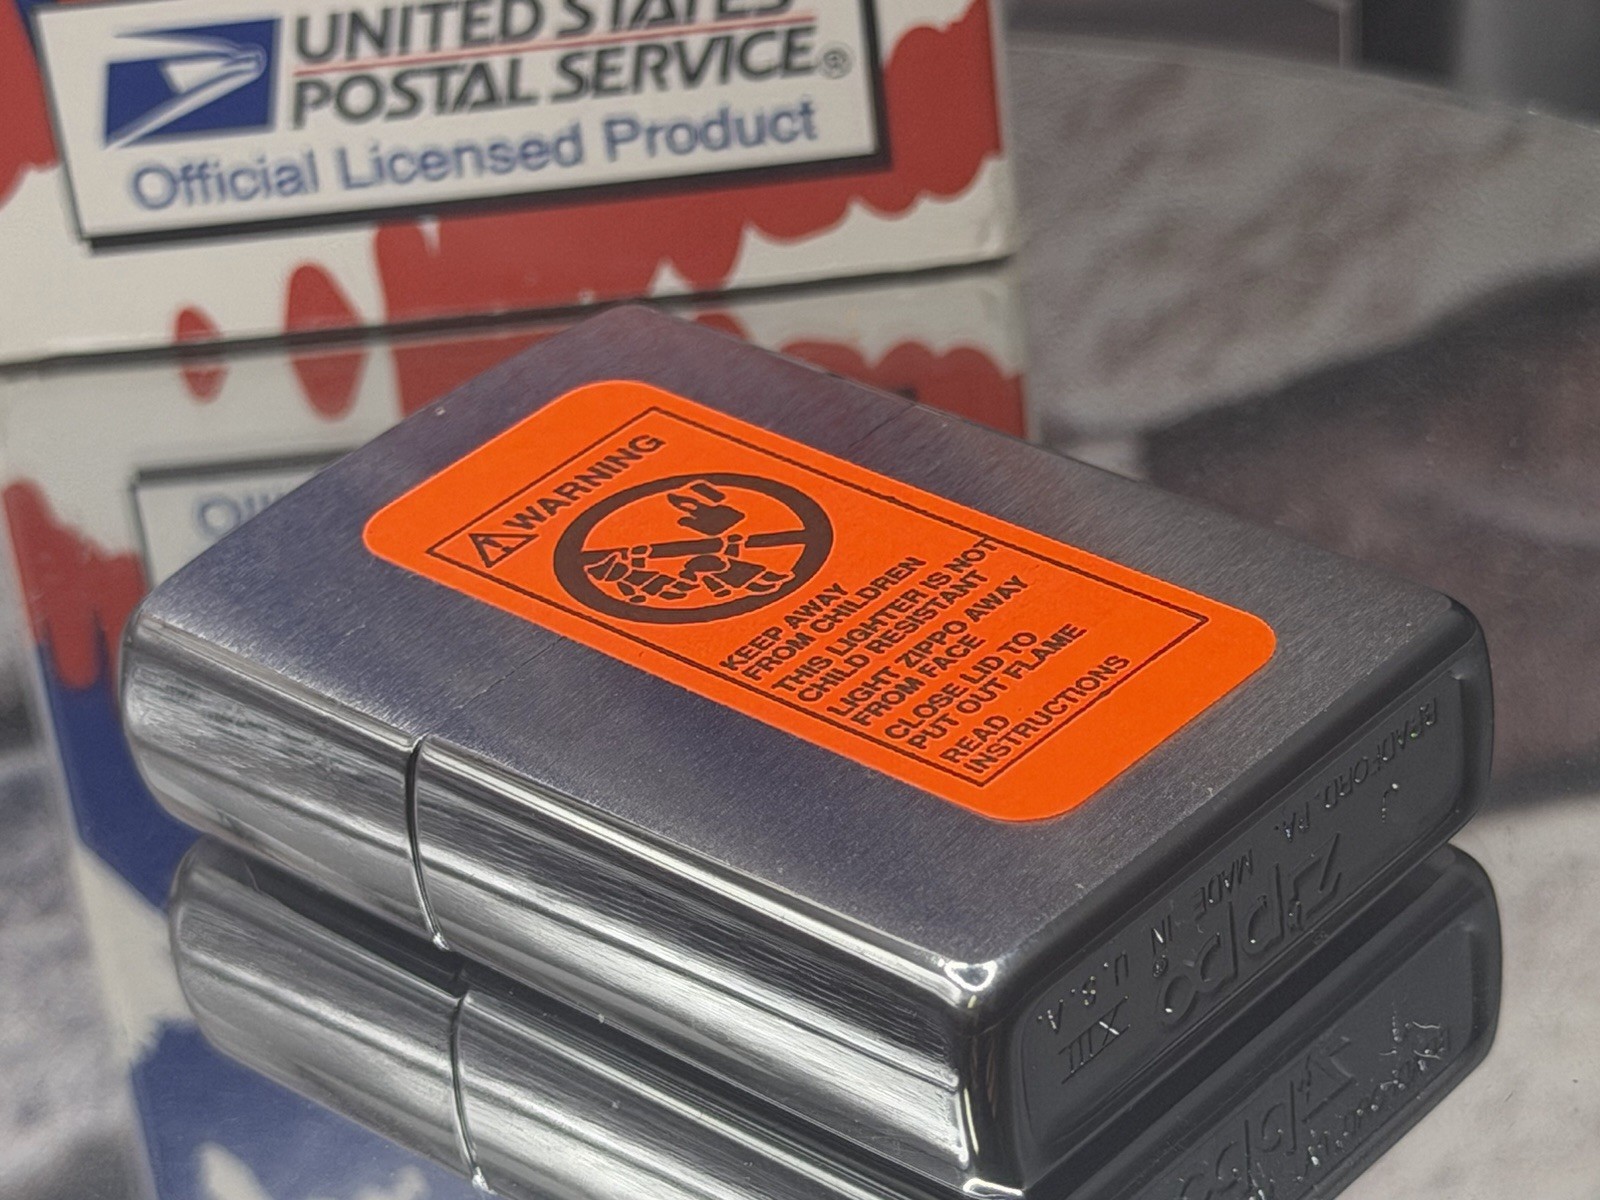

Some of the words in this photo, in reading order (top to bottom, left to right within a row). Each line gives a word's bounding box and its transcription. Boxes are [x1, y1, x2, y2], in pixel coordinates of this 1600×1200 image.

[295, 0, 545, 64] UNITED
[292, 58, 542, 130] POSTAL
[132, 150, 318, 210] Official
[338, 123, 583, 190] Licensed
[605, 99, 818, 162] Product
[502, 433, 667, 530] WARNING
[719, 626, 783, 671] KEEP
[785, 583, 848, 630] AWAY
[742, 632, 815, 681] FROM
[810, 557, 926, 633] CHILDREN
[772, 656, 833, 692] THIS
[827, 589, 927, 657] LIGHTER
[921, 572, 952, 591] IS
[945, 538, 1000, 573] NOT
[797, 655, 870, 702] CHILD
[865, 570, 988, 654] RESISTANT
[827, 667, 901, 717] LIGHT
[896, 620, 968, 669] ZIPPO
[965, 575, 1029, 622] AWAY
[851, 677, 925, 726] FROM
[918, 634, 984, 678] FACE
[885, 684, 968, 739] CLOSE
[959, 656, 1004, 685] LID
[998, 632, 1037, 655] TO
[907, 715, 957, 749] PUT
[956, 678, 1006, 714] OUT
[1003, 625, 1085, 679] FLAME
[964, 656, 1130, 774] INSTRUCTIONS
[941, 717, 1009, 763] READ
[1193, 849, 1253, 921] MADE
[1151, 914, 1173, 955] IN
[1058, 995, 1132, 1085] XIII
